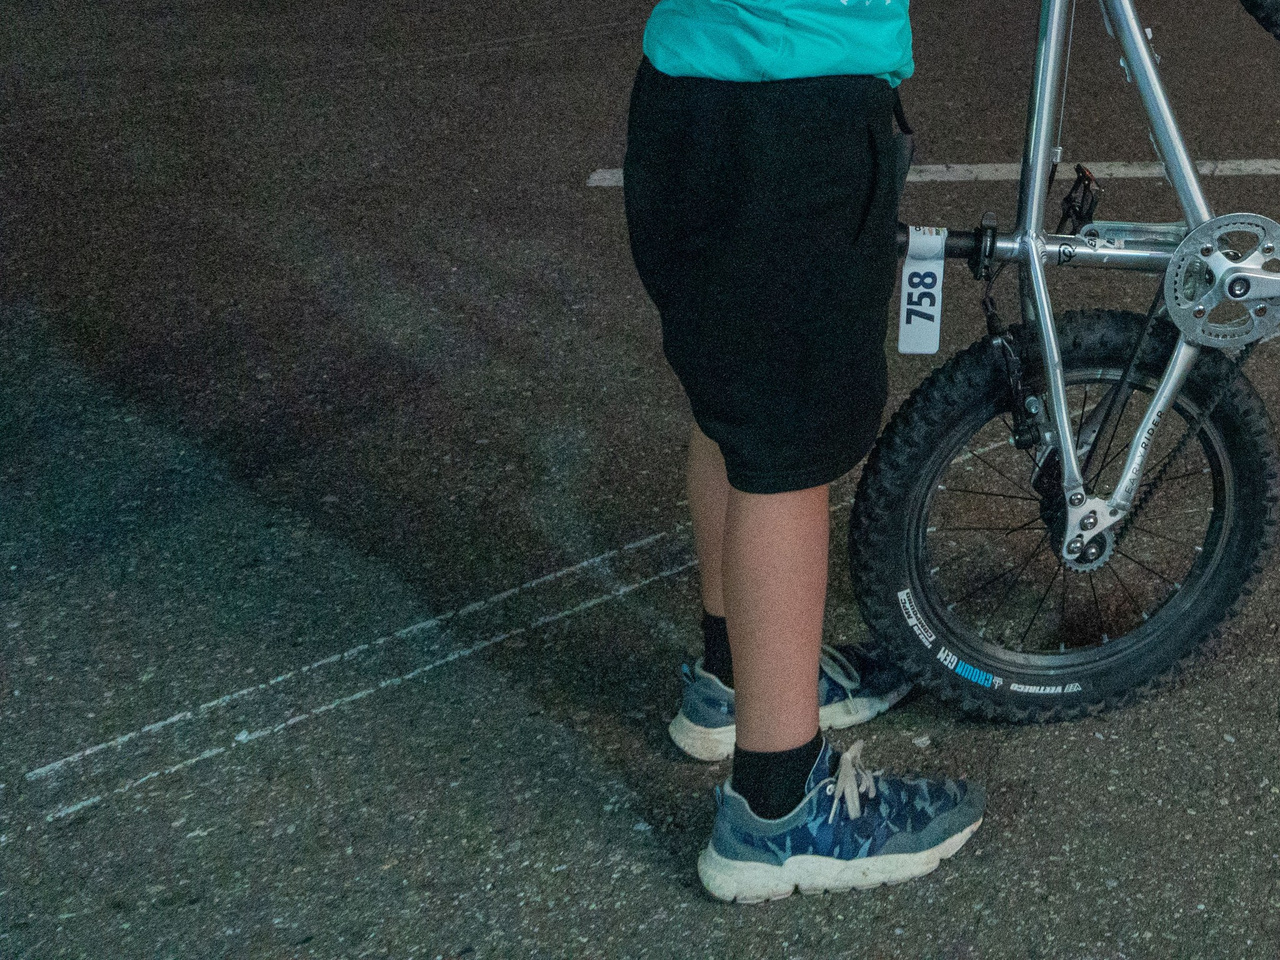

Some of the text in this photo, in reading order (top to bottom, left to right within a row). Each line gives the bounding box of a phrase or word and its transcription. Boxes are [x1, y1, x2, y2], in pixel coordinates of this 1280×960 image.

[905, 271, 938, 325] 758
[900, 598, 914, 620] MPC
[905, 591, 934, 639] COMPOUND
[936, 646, 994, 689] CROWN GEM
